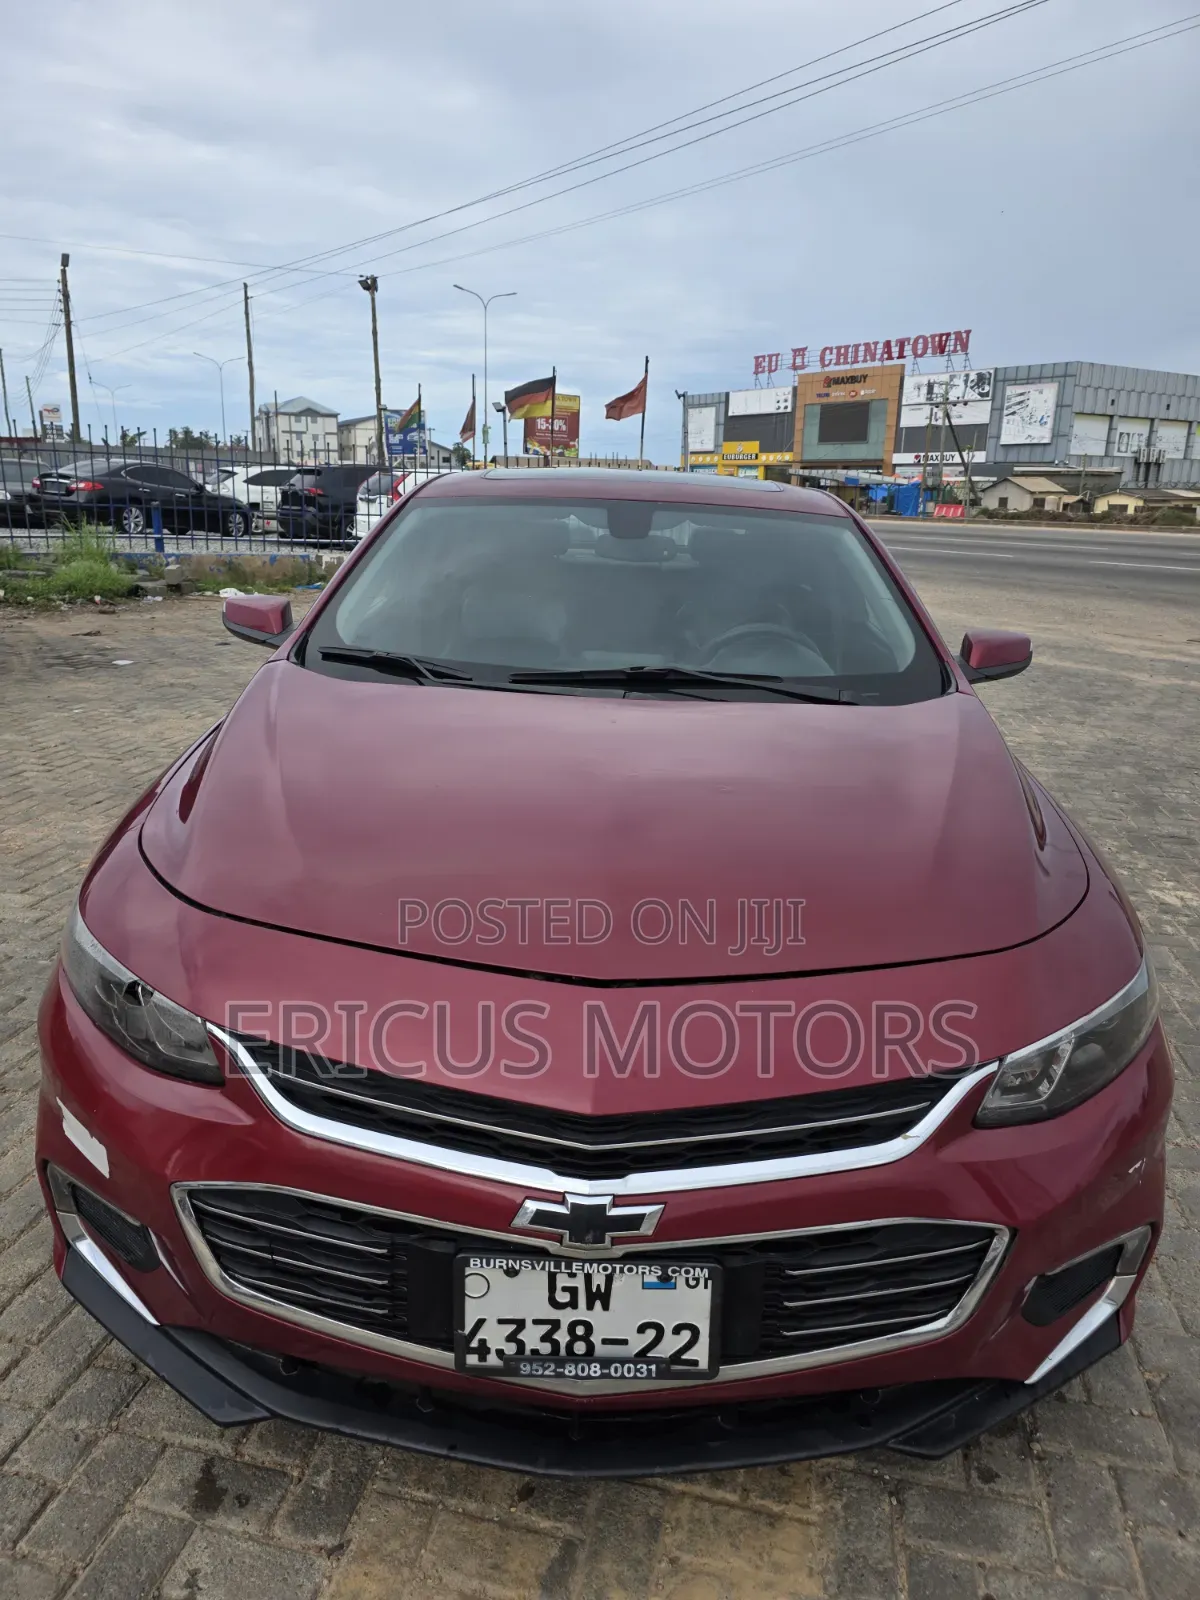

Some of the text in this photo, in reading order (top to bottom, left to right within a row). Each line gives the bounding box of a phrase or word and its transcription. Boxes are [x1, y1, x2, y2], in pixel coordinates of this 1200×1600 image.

[753, 329, 972, 375] EU CHINATOWN
[832, 374, 868, 385] MAXBUY
[469, 1258, 662, 1276] BURNSVILLEMOTORS
[547, 1272, 614, 1311] GW
[465, 1317, 700, 1367] 4338-22
[520, 1362, 657, 1377] 952-808-0031
